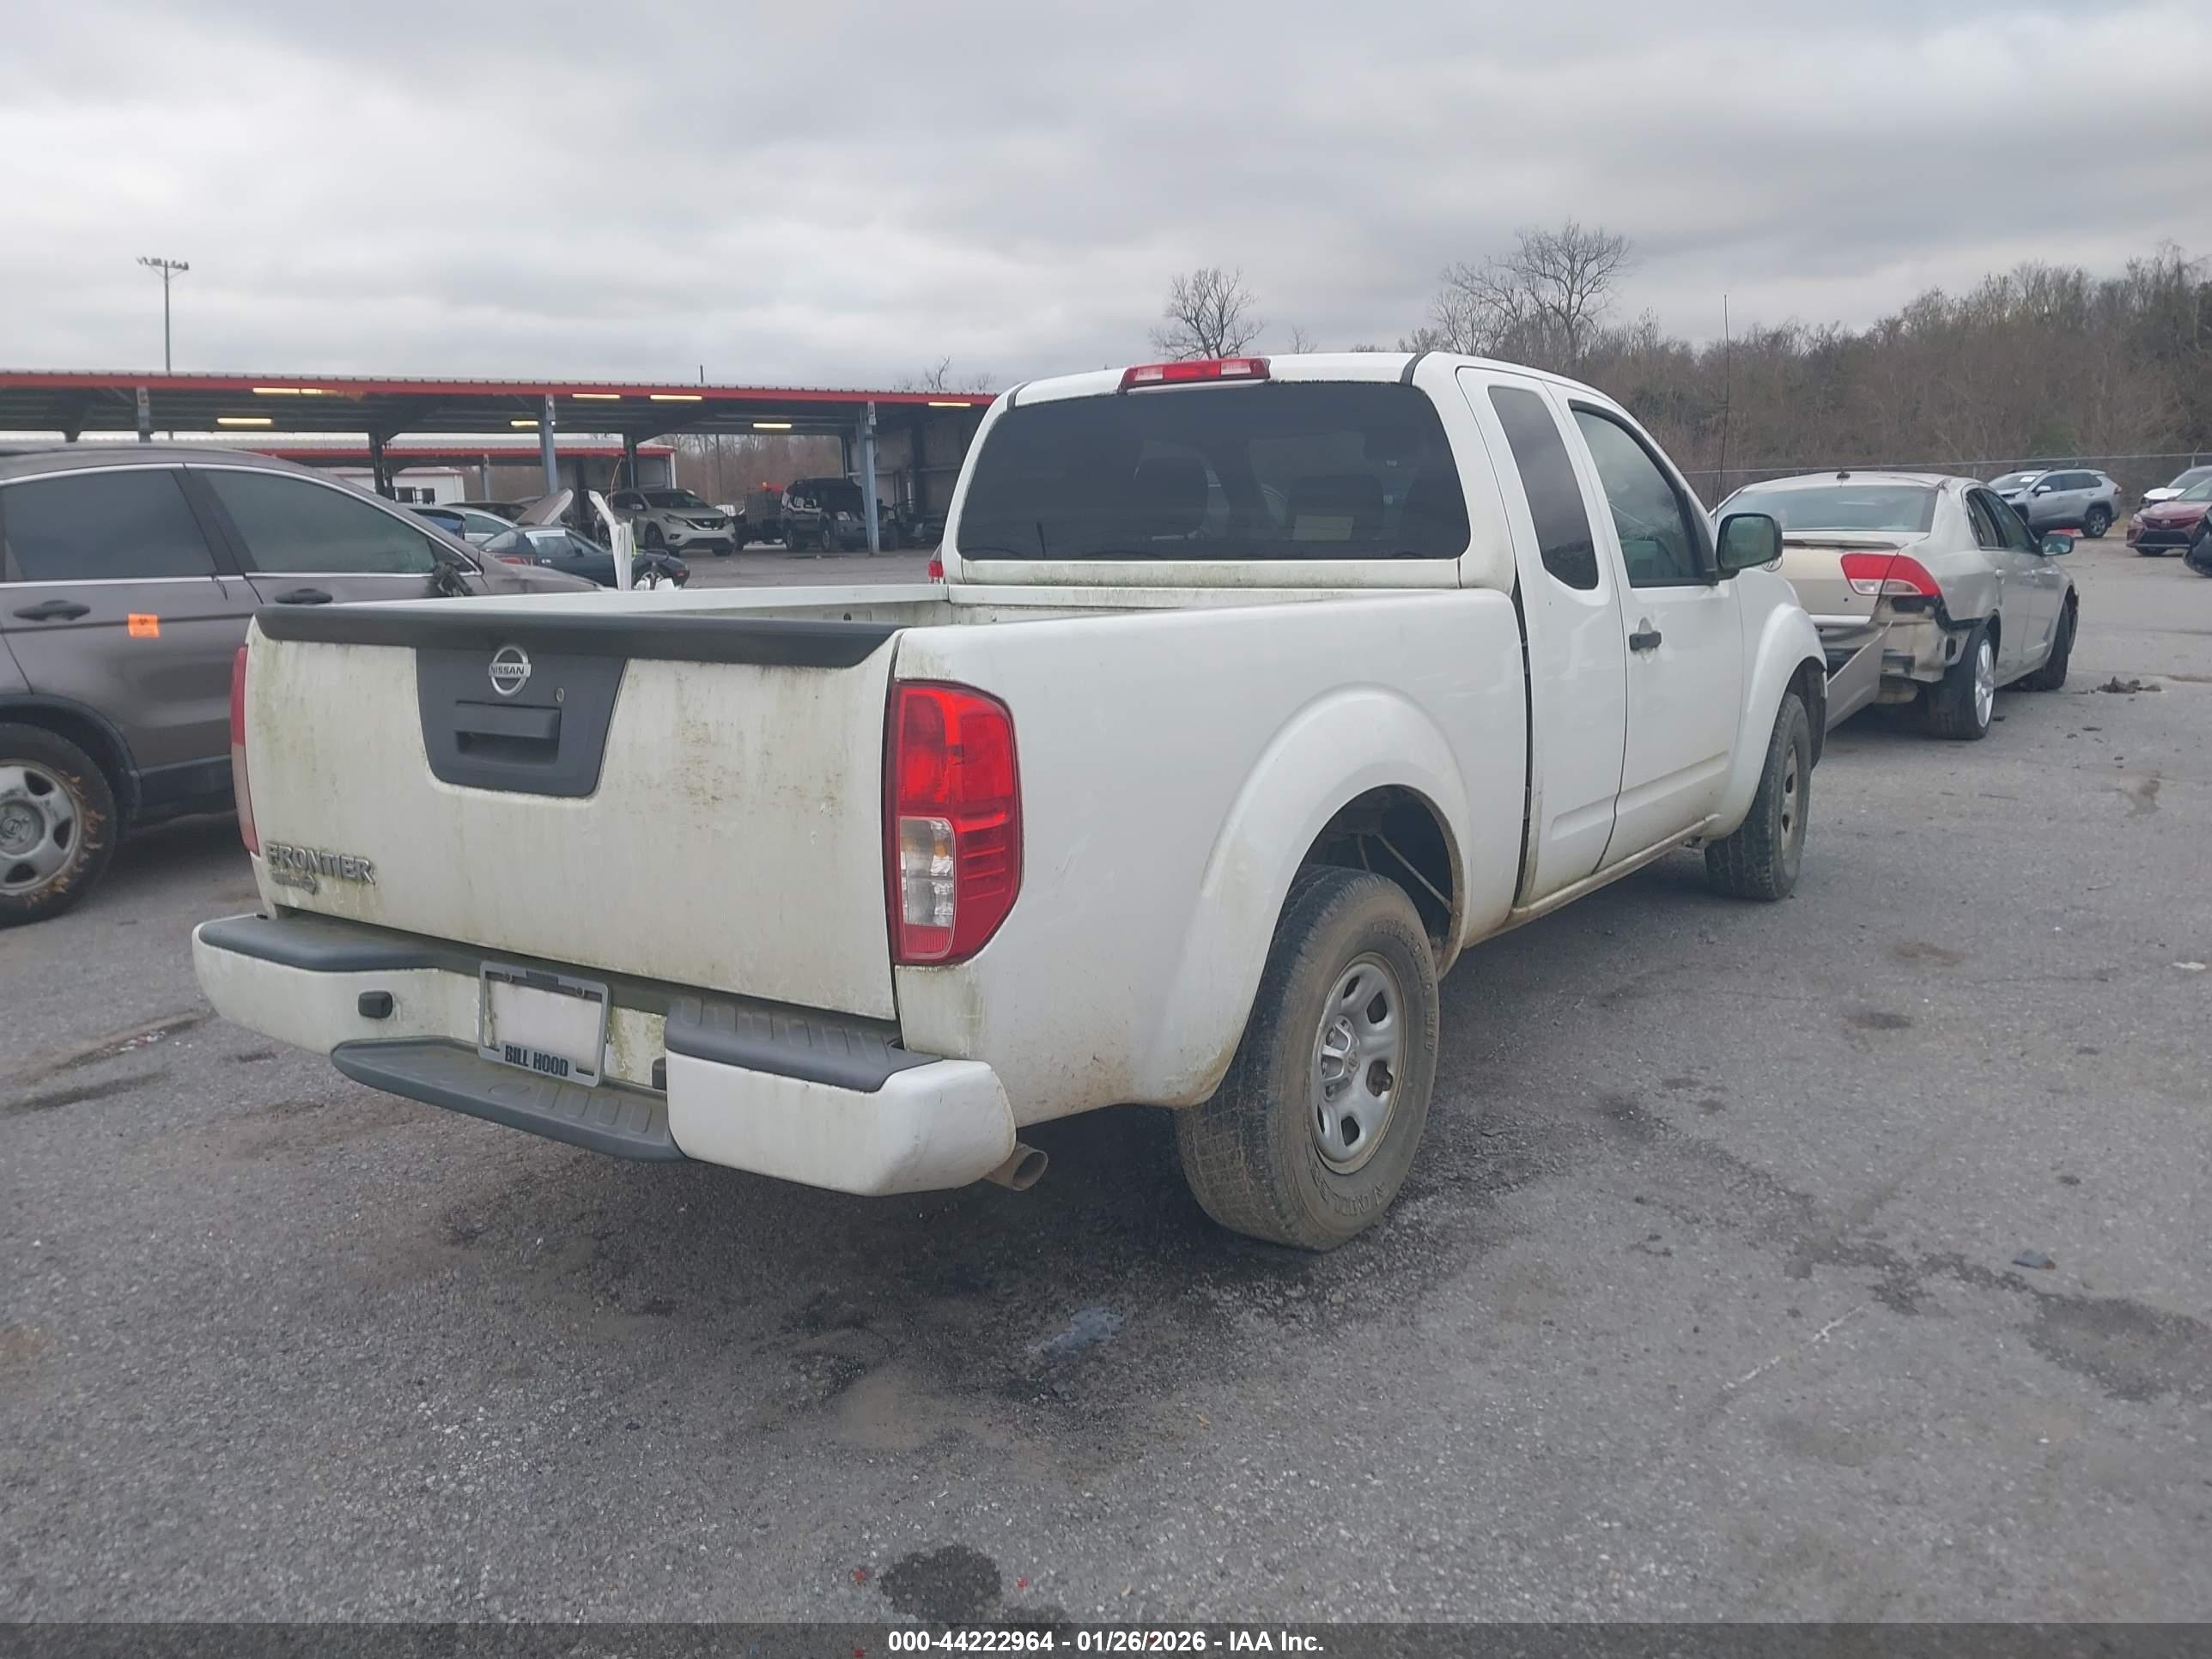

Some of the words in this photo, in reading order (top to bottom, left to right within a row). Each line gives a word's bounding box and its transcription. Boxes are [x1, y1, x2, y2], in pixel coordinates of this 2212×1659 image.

[489, 664, 526, 675] NISSAN
[265, 842, 376, 886] FRONTIER
[505, 1043, 530, 1067] BILL
[532, 1052, 569, 1078] HOOD
